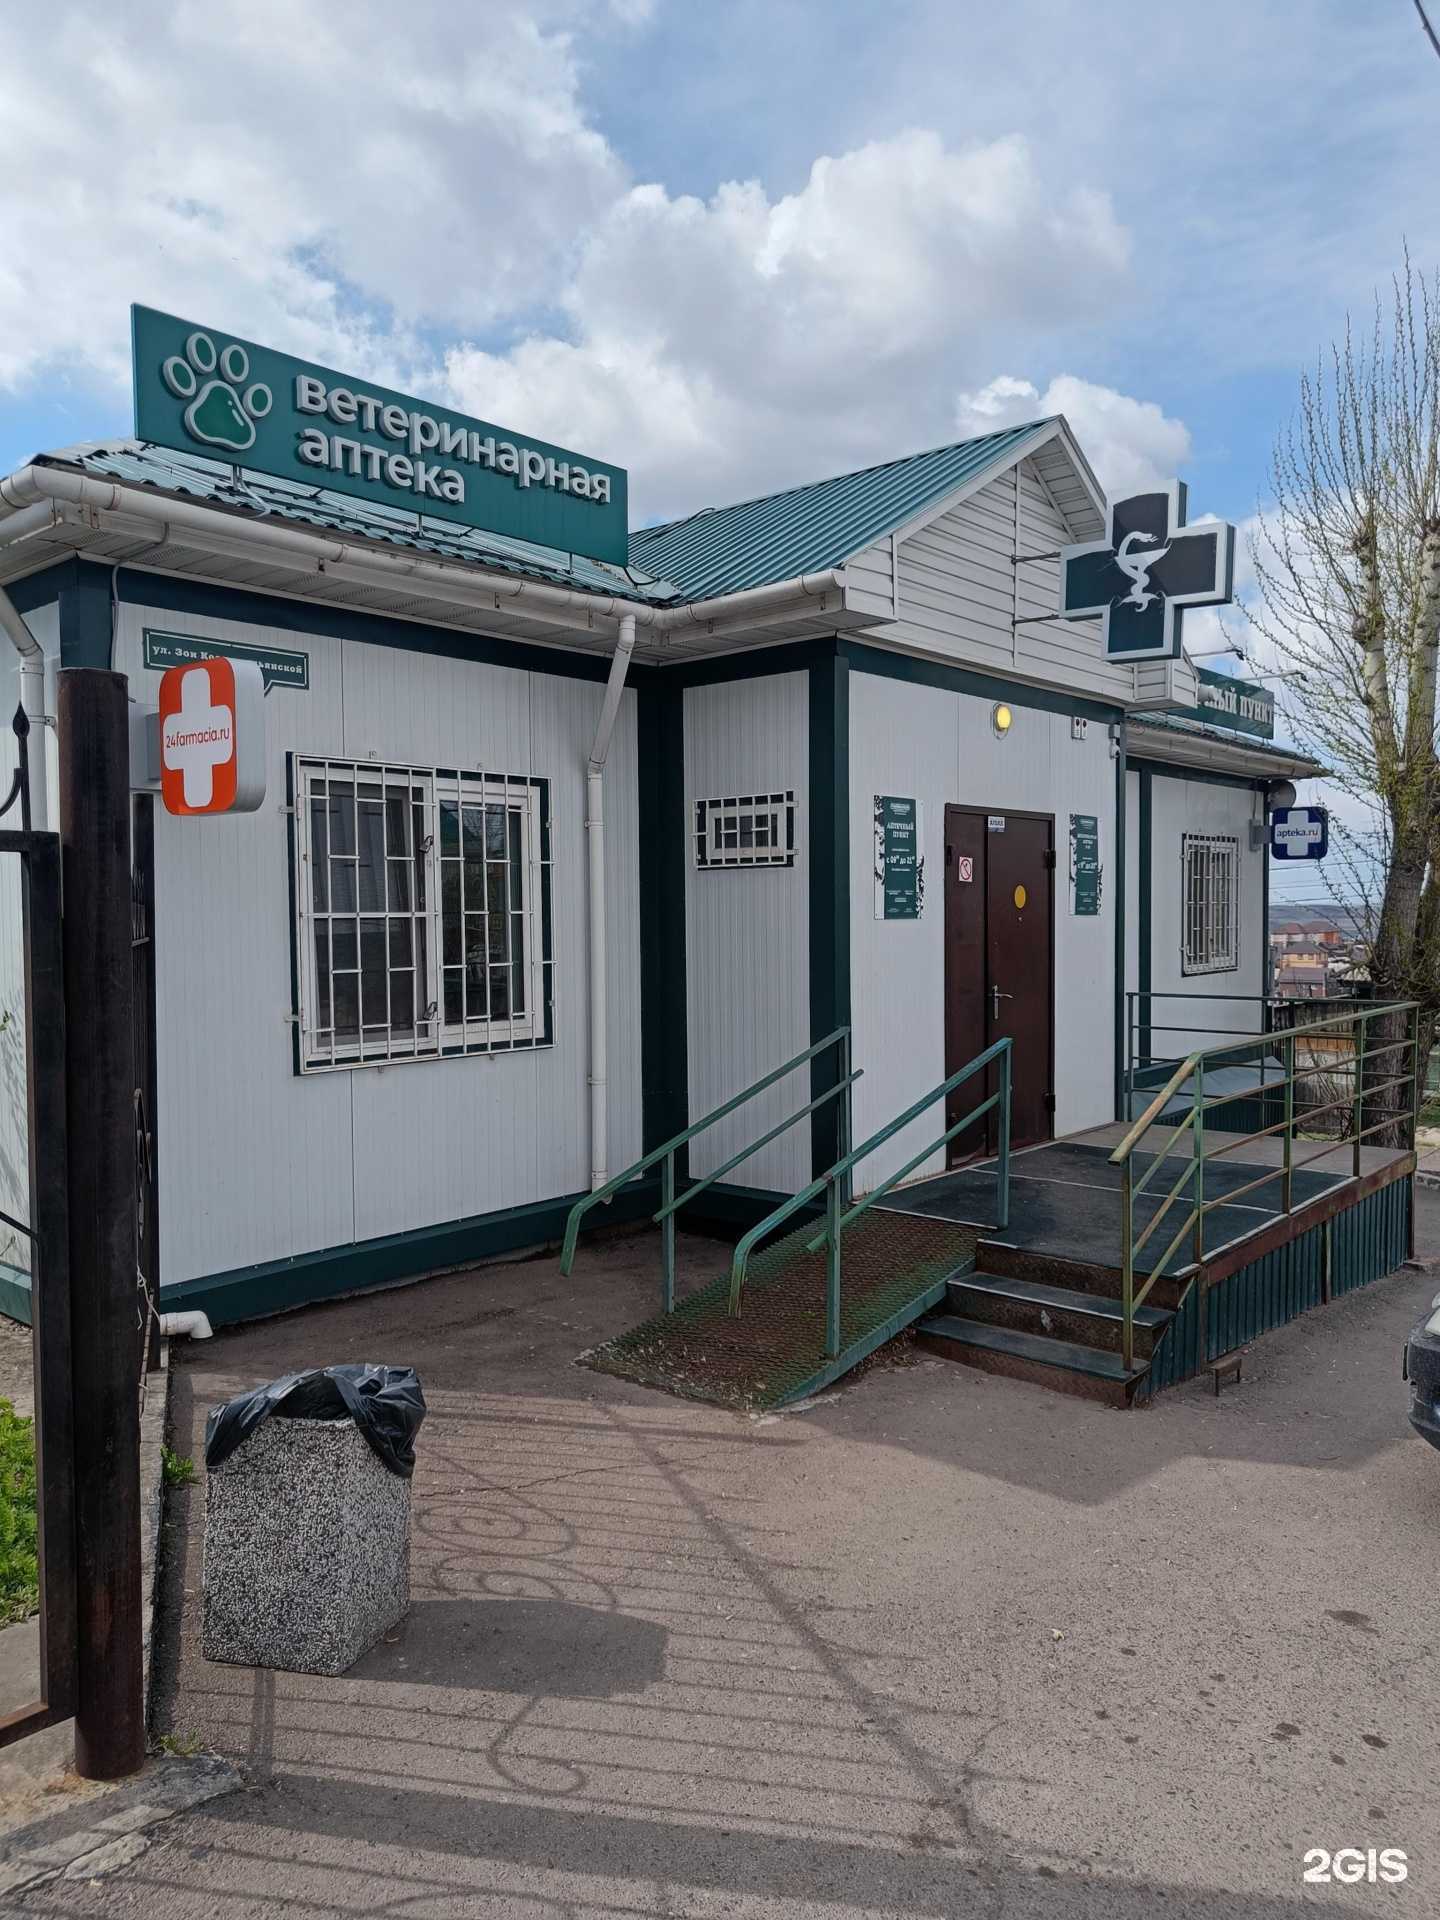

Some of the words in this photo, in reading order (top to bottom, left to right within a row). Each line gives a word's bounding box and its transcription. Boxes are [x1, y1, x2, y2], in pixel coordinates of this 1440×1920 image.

[297, 427, 465, 504] аптека
[152, 646, 171, 655] ул.
[174, 647, 197, 659] Зои
[1240, 695, 1273, 724] ПУНКТ
[166, 727, 230, 748] 24farmacia.ru
[1276, 828, 1318, 838] apteka.ru
